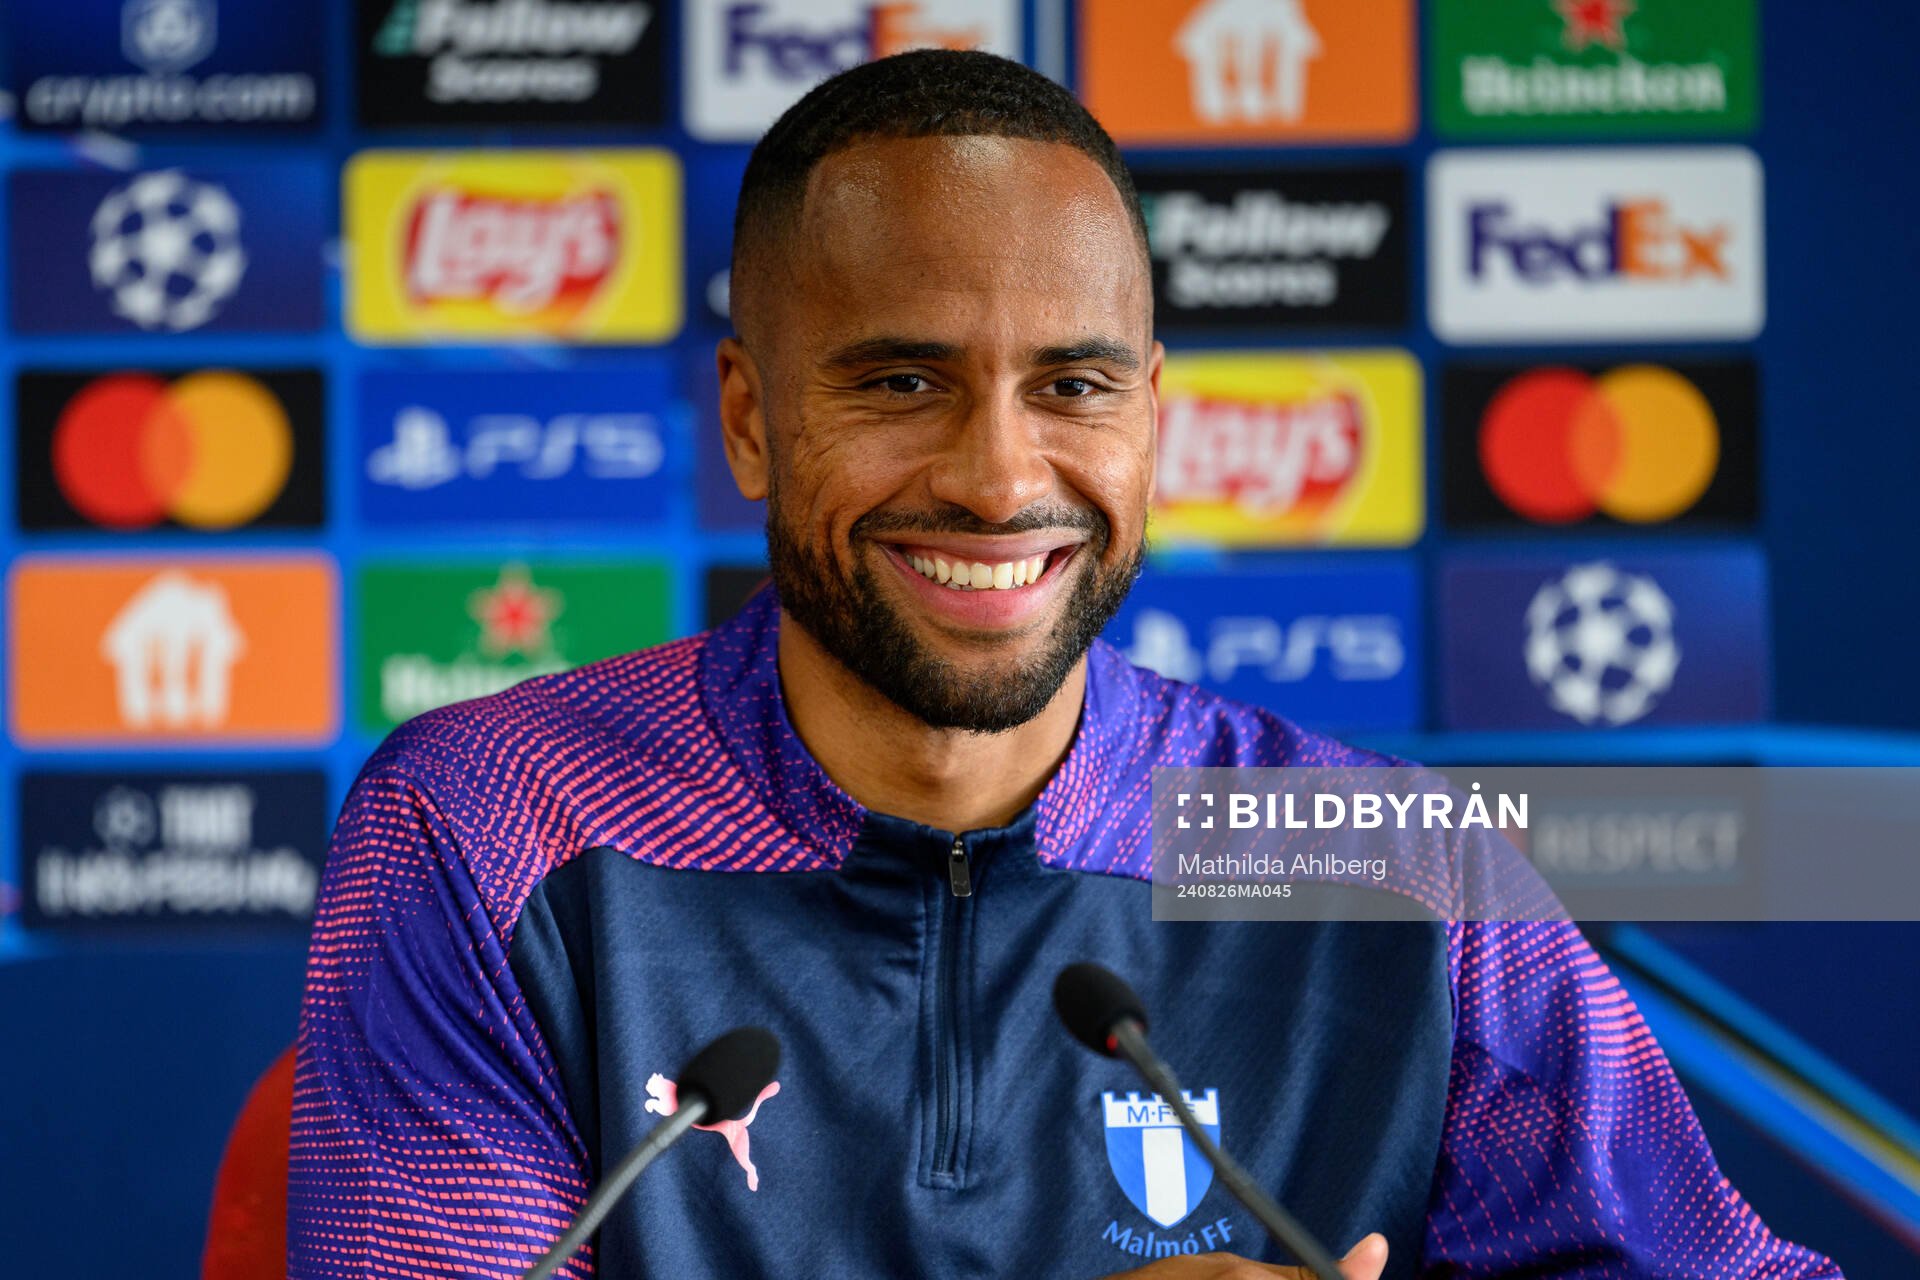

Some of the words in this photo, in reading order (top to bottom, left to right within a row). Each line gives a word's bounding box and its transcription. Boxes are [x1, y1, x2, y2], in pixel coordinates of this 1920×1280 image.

[1460, 54, 1727, 115] Heineken
[1155, 190, 1391, 259] Follow
[1464, 199, 1732, 285] FedEx
[1201, 1217, 1233, 1251] FF
